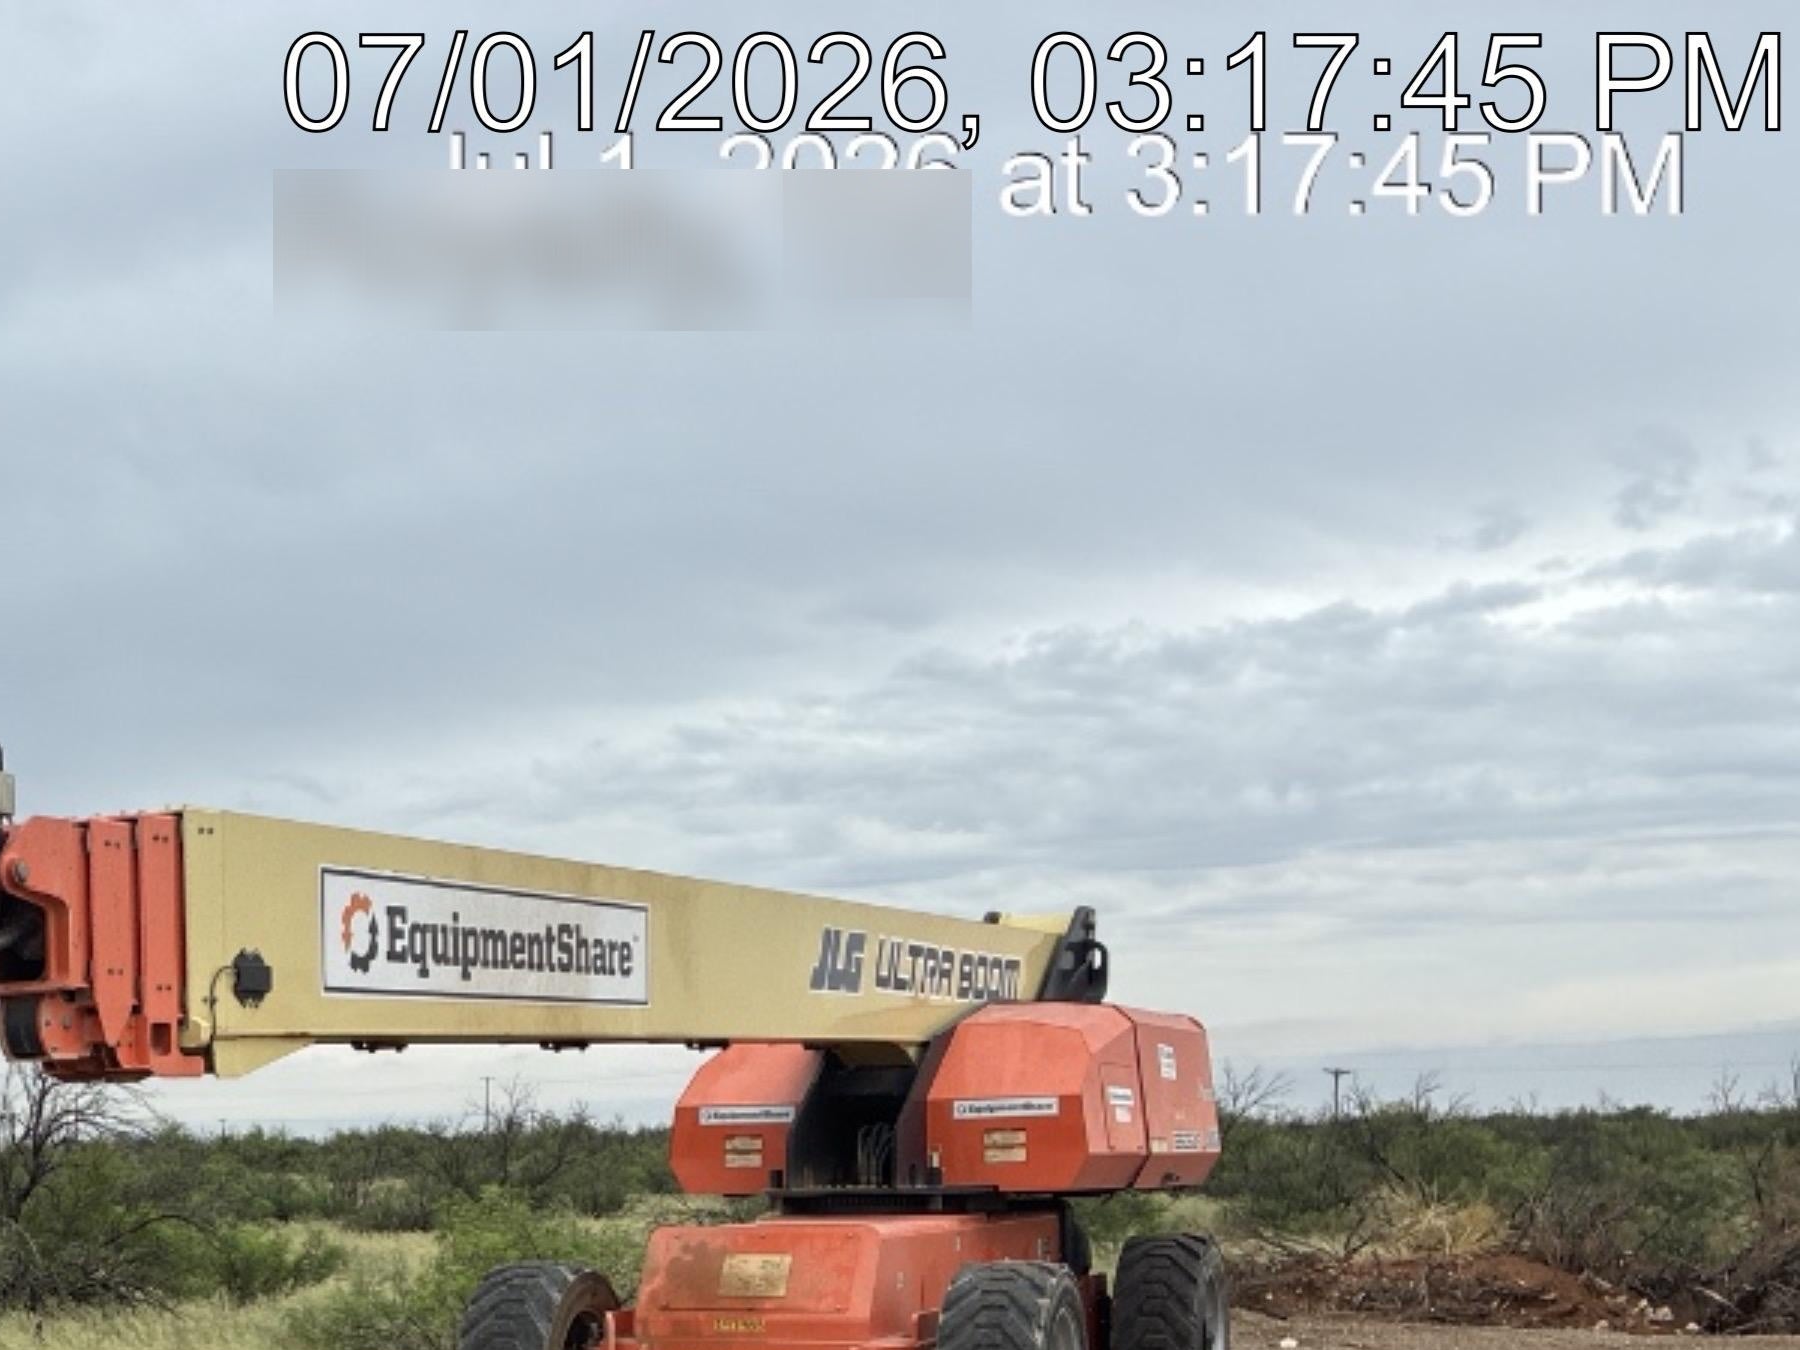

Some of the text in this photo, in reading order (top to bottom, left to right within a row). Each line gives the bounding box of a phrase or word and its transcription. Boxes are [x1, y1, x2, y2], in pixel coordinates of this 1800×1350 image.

[386, 905, 633, 981] EquipmentShare
[808, 926, 868, 995] JLG
[874, 934, 956, 1000] ULTRA
